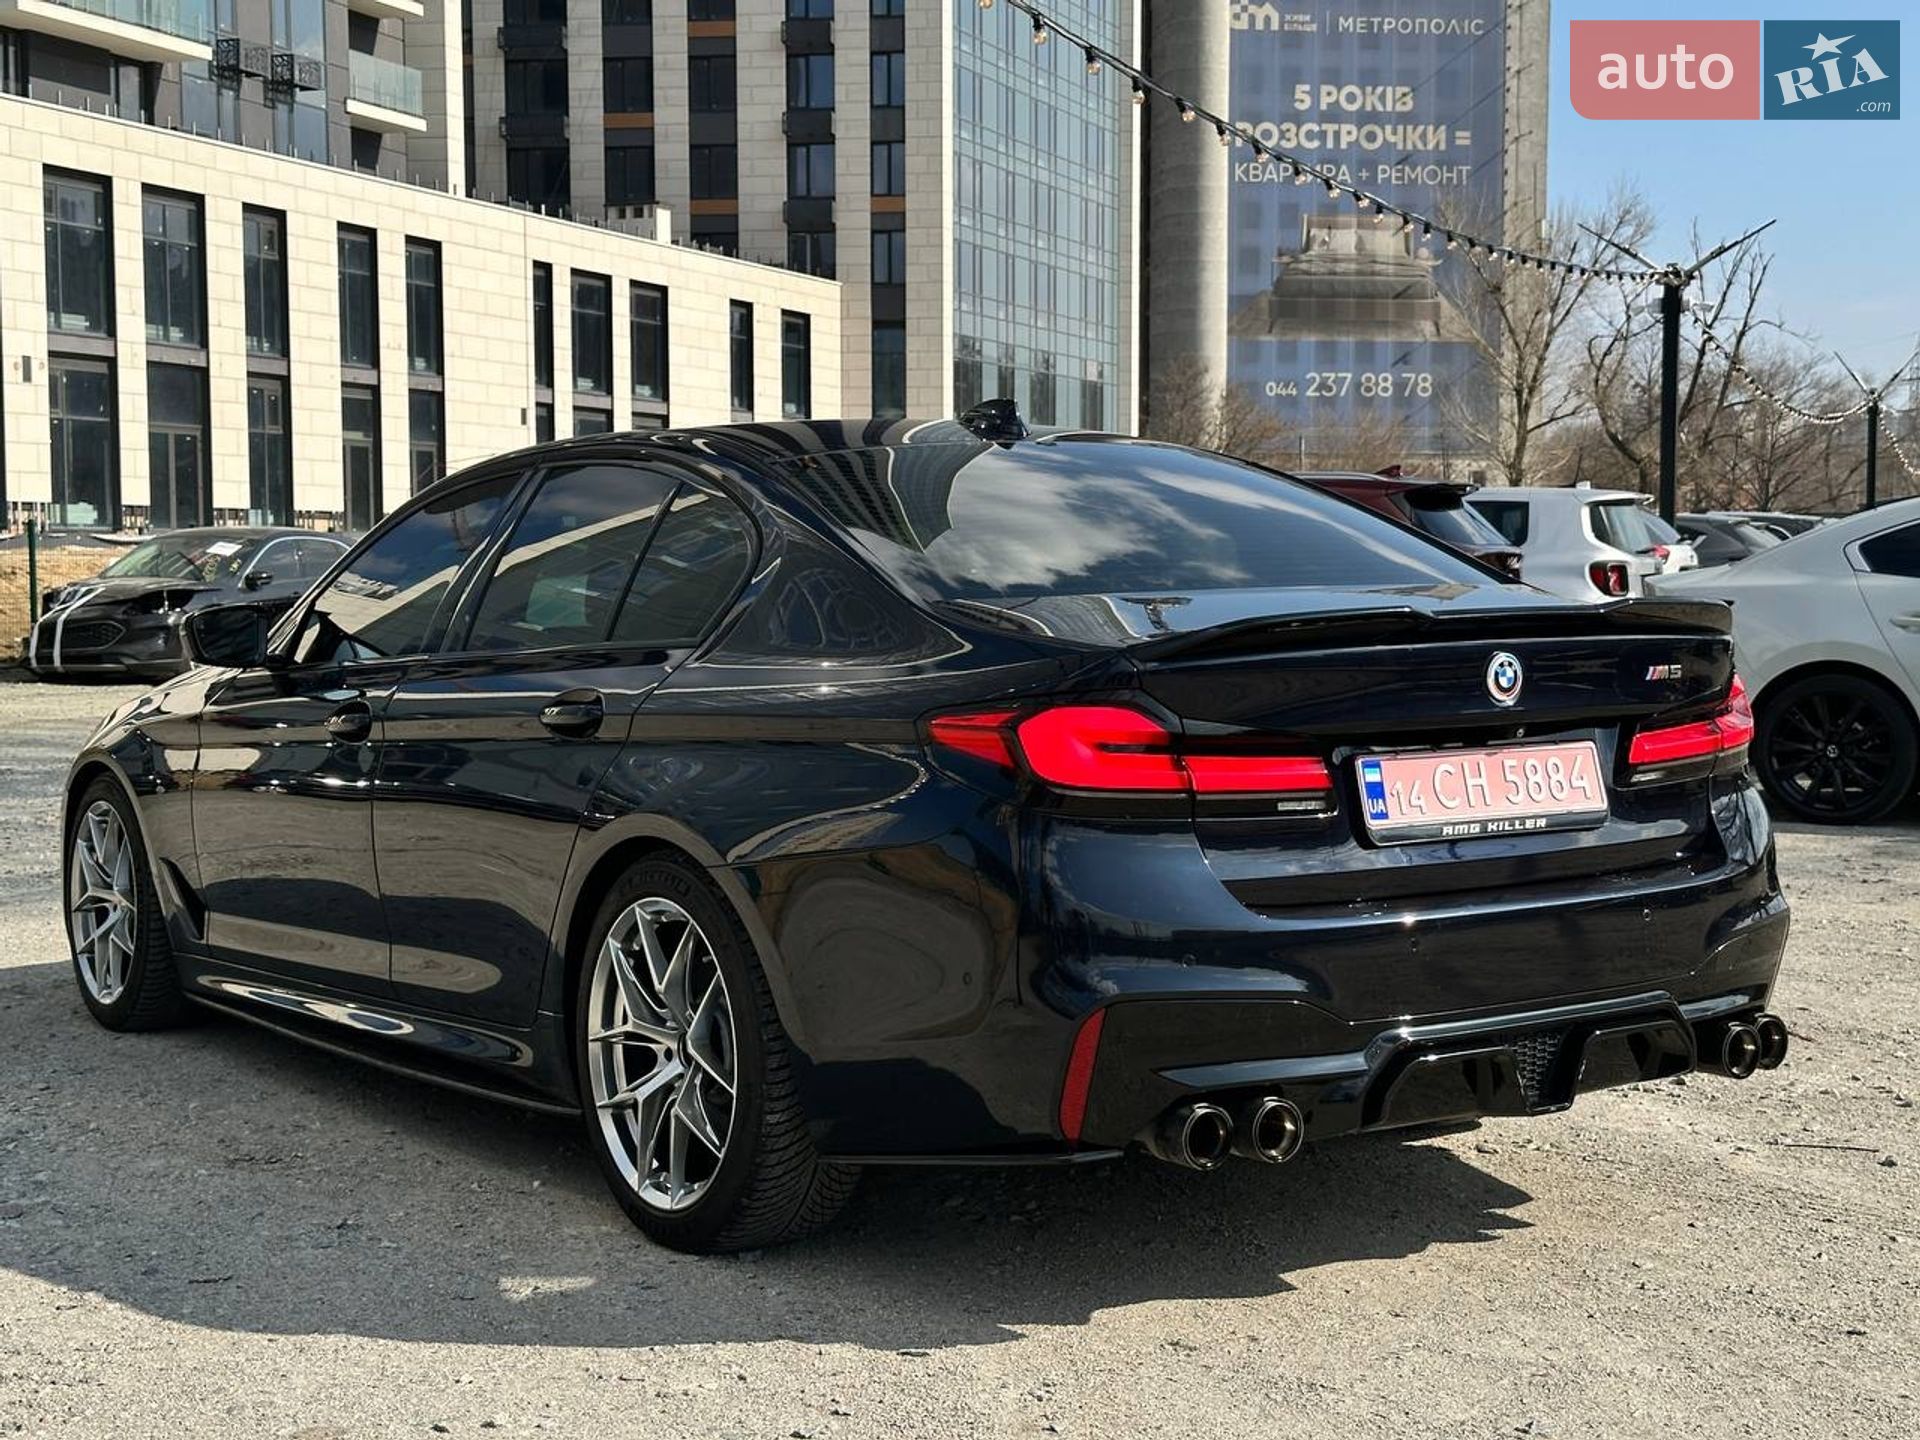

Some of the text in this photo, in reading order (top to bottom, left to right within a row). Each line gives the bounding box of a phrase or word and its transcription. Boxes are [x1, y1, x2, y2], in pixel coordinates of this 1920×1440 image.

[1338, 16, 1485, 35] МЕТРОПОЛІС
[1294, 84, 1414, 112] 5 РОКІВ
[1235, 121, 1446, 150] РОЗСТРОЧКИ
[1377, 165, 1471, 185] РЕМОНТ
[1265, 372, 1433, 398] 044 237 88 78
[1389, 754, 1592, 816] 14 CH 5884
[1368, 798, 1387, 814] UA
[1442, 818, 1547, 836] AMG KILLER
